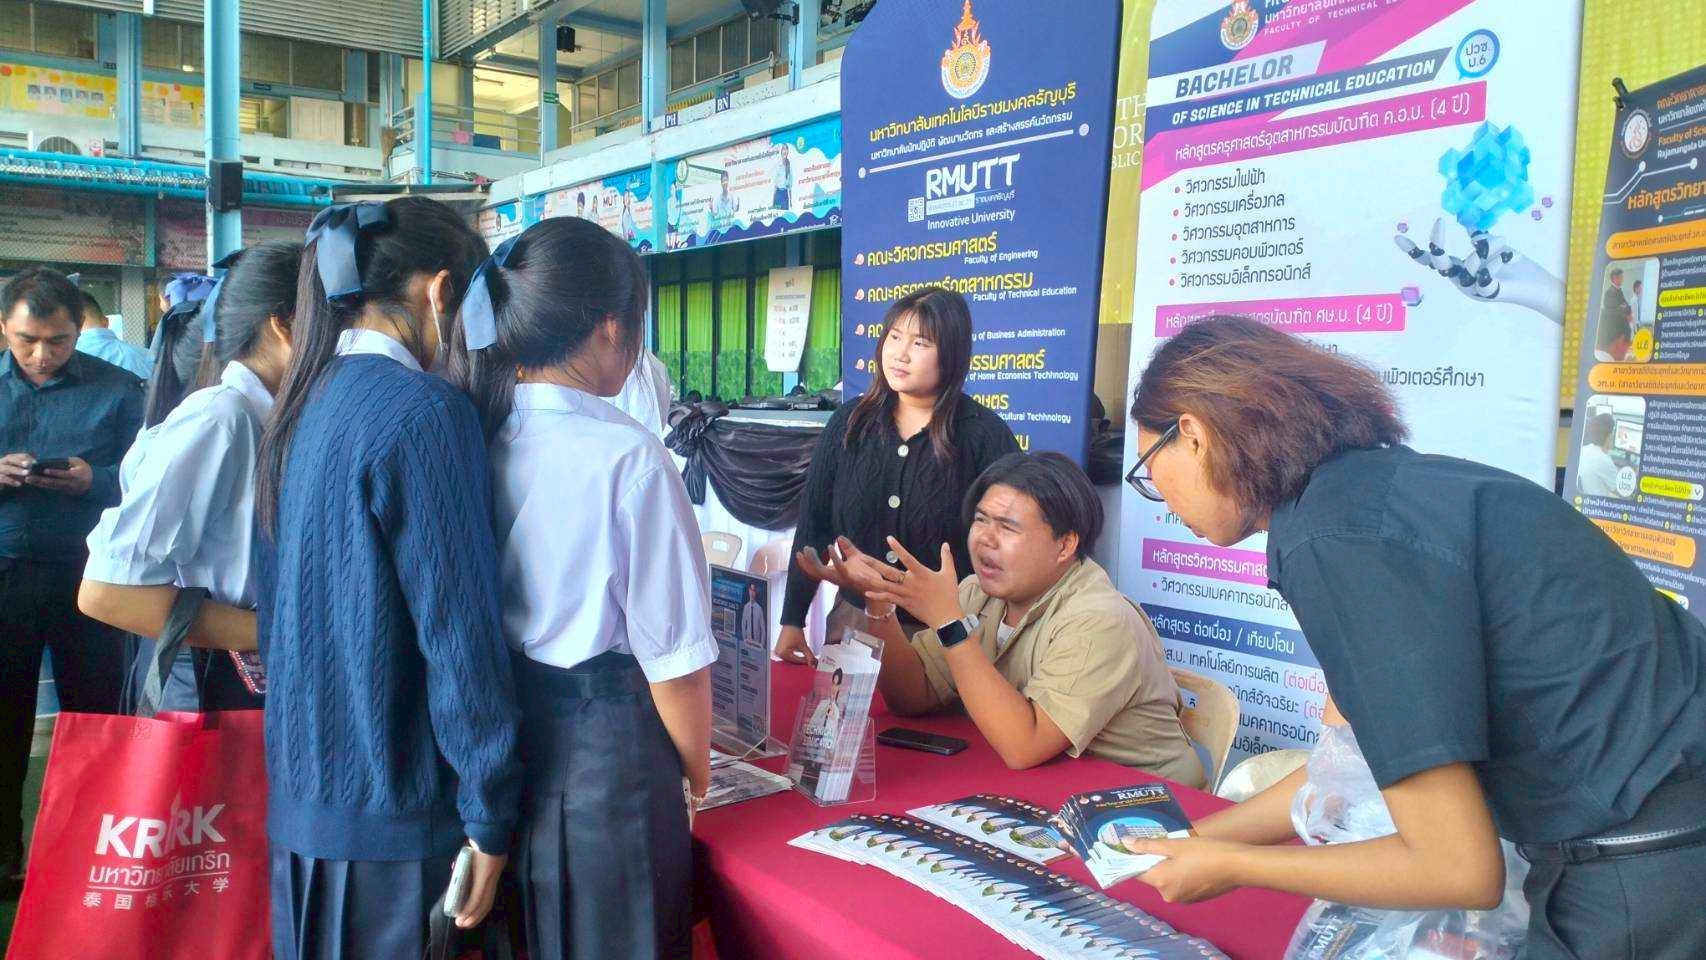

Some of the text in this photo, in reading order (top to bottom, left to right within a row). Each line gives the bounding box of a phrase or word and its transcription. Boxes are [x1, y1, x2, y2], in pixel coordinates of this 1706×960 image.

[1264, 2, 1378, 35] FACULTY OF TECHNICAL
[1176, 54, 1294, 99] BACHELOR
[1172, 59, 1436, 125] OF SCIENCE IN TECHNICAL EDUCATION
[926, 153, 1021, 200] RMUTT
[1186, 168, 1266, 194] วิศวกรรมไฟฟ้า
[1184, 192, 1286, 218] วิศวกรรมเครื่องกล
[927, 208, 1016, 230] Innovative University
[1183, 215, 1296, 242] วิศวกรรมอุตสาหการ
[867, 231, 998, 267] คณะวิศวกรรมศาสตร์
[964, 249, 1039, 265] Faculty of Engineering
[1181, 238, 1305, 265] วิศวกรรมคอมพิวเตอร์
[1180, 262, 1312, 288] วิศวกรรมอิเล็กทรอนิกส์
[973, 285, 1077, 302] Faculty of Technical Education
[986, 330, 1016, 340] Business
[1017, 328, 1066, 338] Administration
[970, 372, 977, 381] of
[977, 372, 996, 381] Home
[997, 371, 1031, 381] Economics
[1161, 577, 1288, 611] วิศวกรรมเมคคาทรอนิกส
[1194, 619, 1232, 642] ต่อเนื่อง
[1246, 631, 1296, 655] เทียบโอน
[1164, 647, 1187, 664] ส.บ.
[1189, 649, 1280, 684] เทคโนโลยีการผลิต
